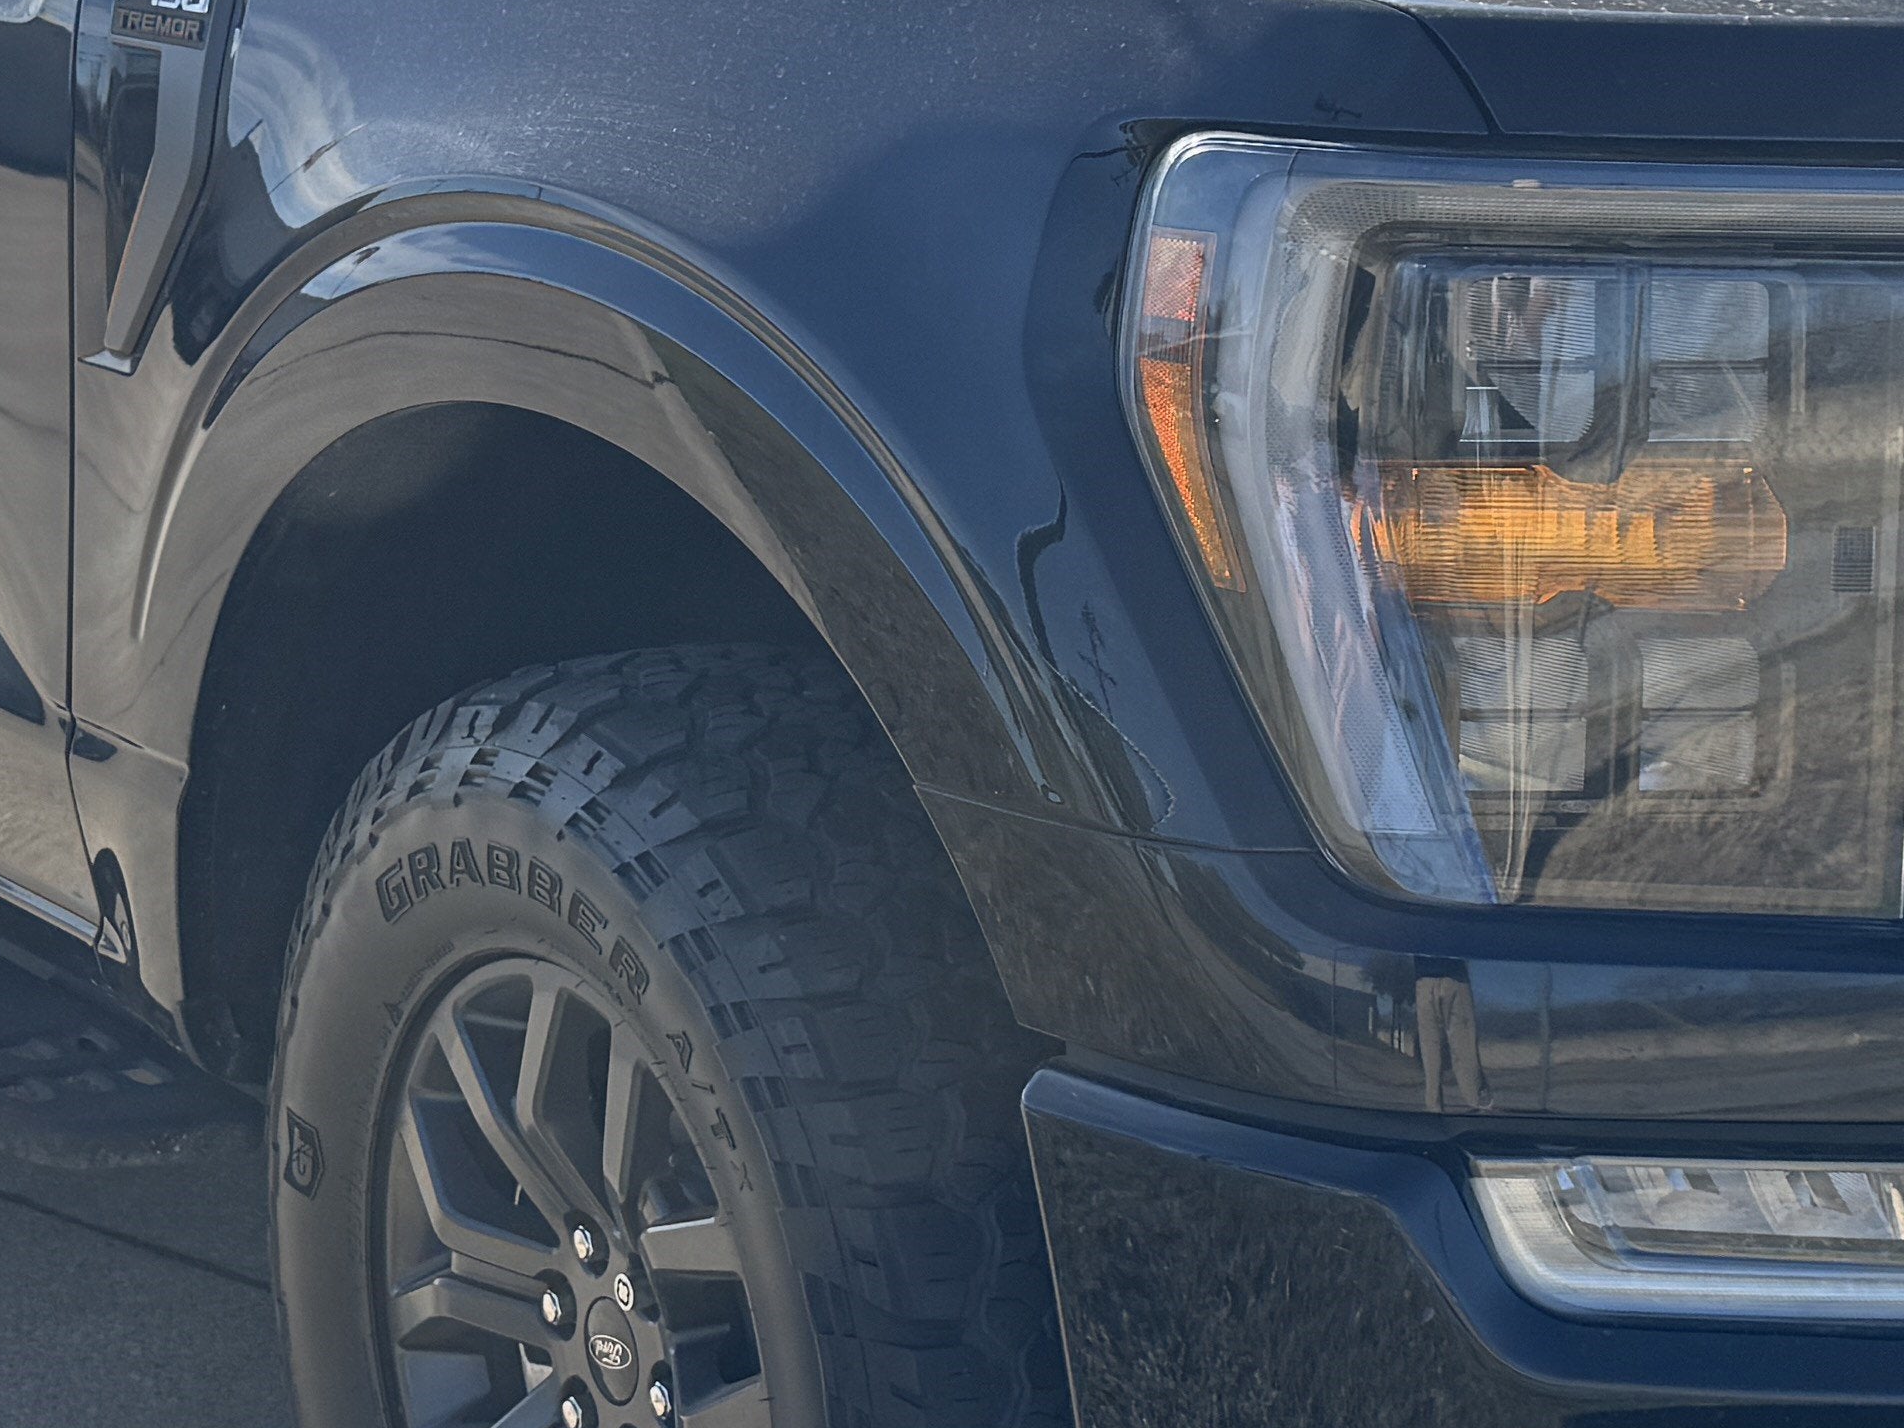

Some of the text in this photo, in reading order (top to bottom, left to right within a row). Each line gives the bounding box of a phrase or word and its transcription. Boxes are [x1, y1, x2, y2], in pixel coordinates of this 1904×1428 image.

[116, 7, 204, 43] TREMOR
[375, 836, 650, 1006] GRABBER
[594, 1338, 623, 1366] Ford
